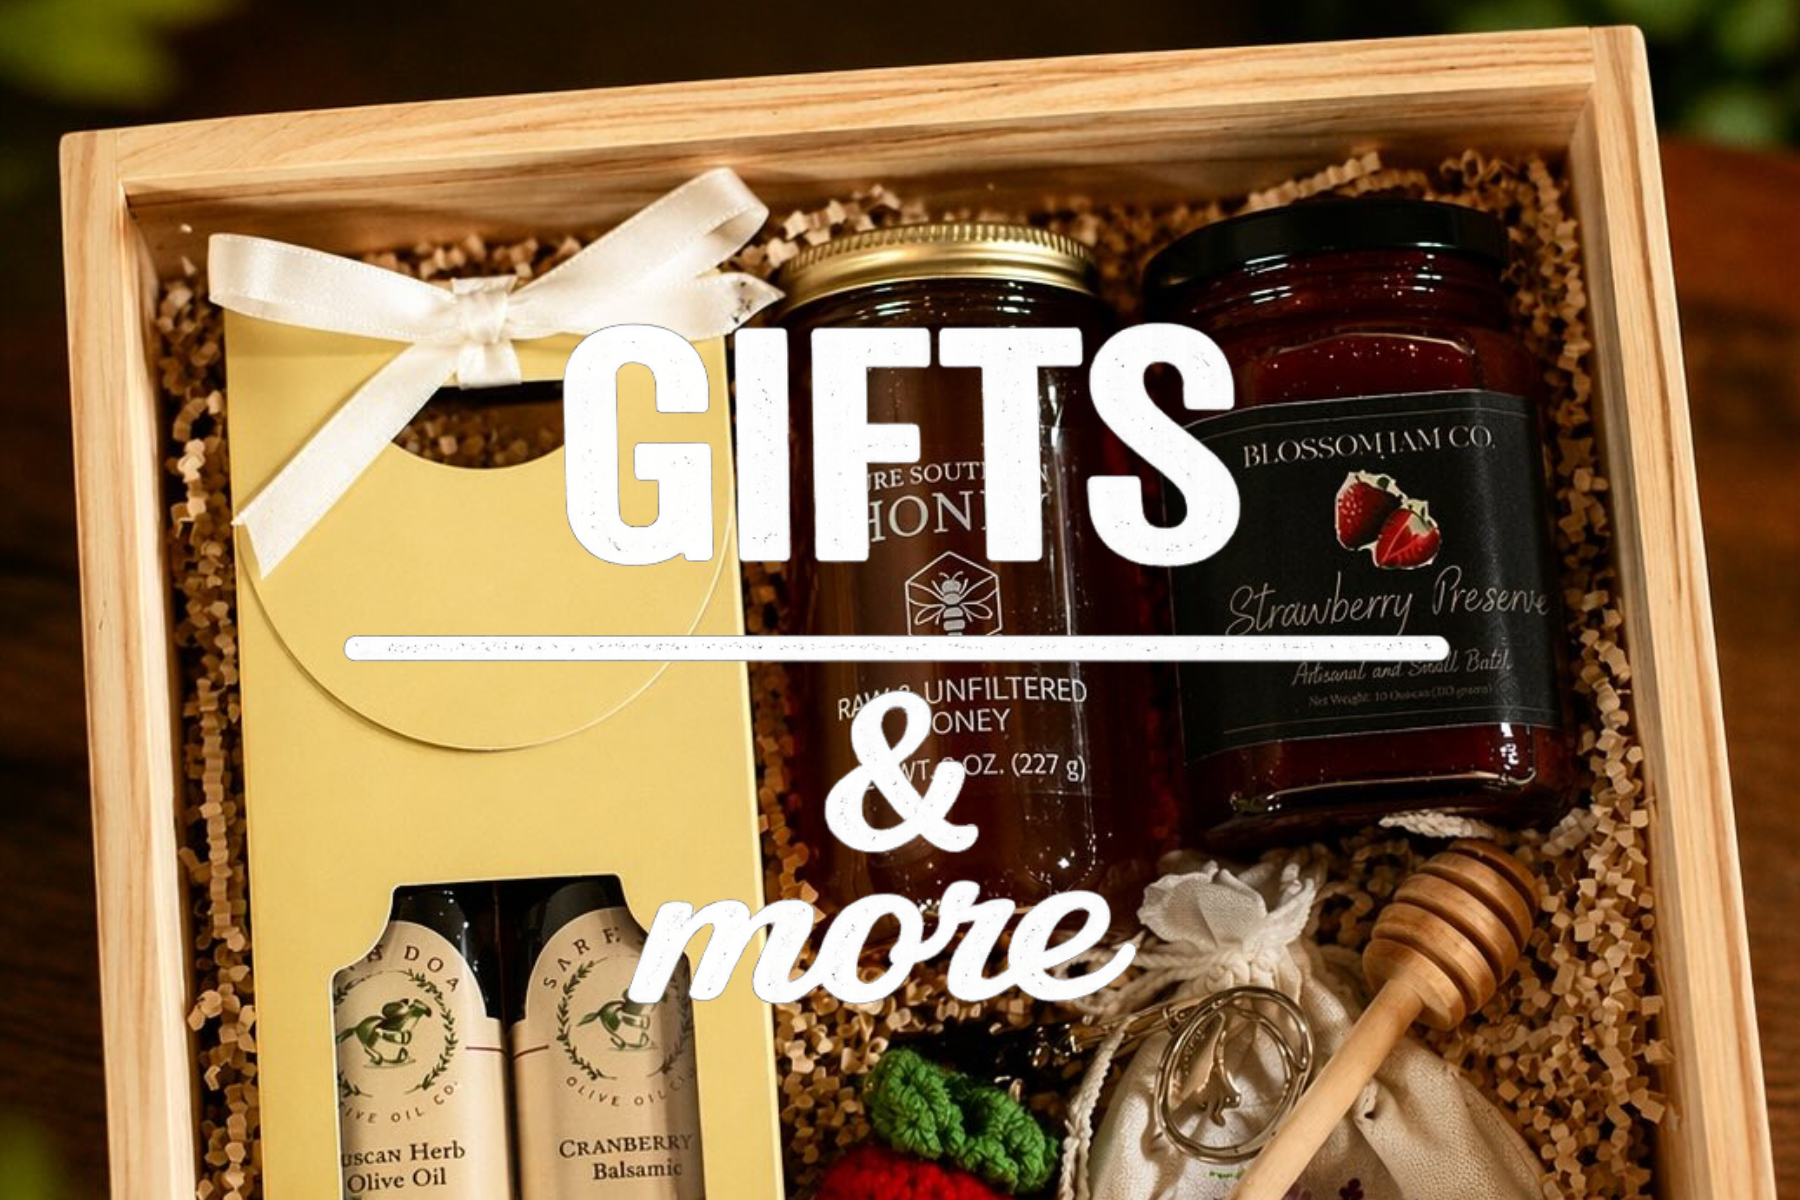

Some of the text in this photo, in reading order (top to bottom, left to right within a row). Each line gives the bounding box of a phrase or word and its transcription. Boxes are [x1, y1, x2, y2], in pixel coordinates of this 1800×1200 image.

[1243, 433, 1382, 468] BLOSSOM
[1448, 424, 1496, 449] CO.
[1225, 571, 1413, 635] Strawberry
[1291, 660, 1367, 686] Artisanal
[1372, 660, 1405, 679] and
[924, 675, 1087, 704] UNFILTERED
[931, 708, 1011, 735] ONEY
[963, 752, 1005, 777] OZ.
[1011, 752, 1059, 778] (227
[1066, 753, 1087, 783] g)
[390, 1107, 425, 1123] OIL
[433, 1081, 459, 1105] CO.
[566, 1076, 620, 1107] OLIVE
[342, 1139, 466, 1167] uscan Herb
[559, 1133, 694, 1159] CRANBERRY
[347, 1166, 446, 1194] Olive Oil
[592, 1158, 682, 1180] Balsamic
